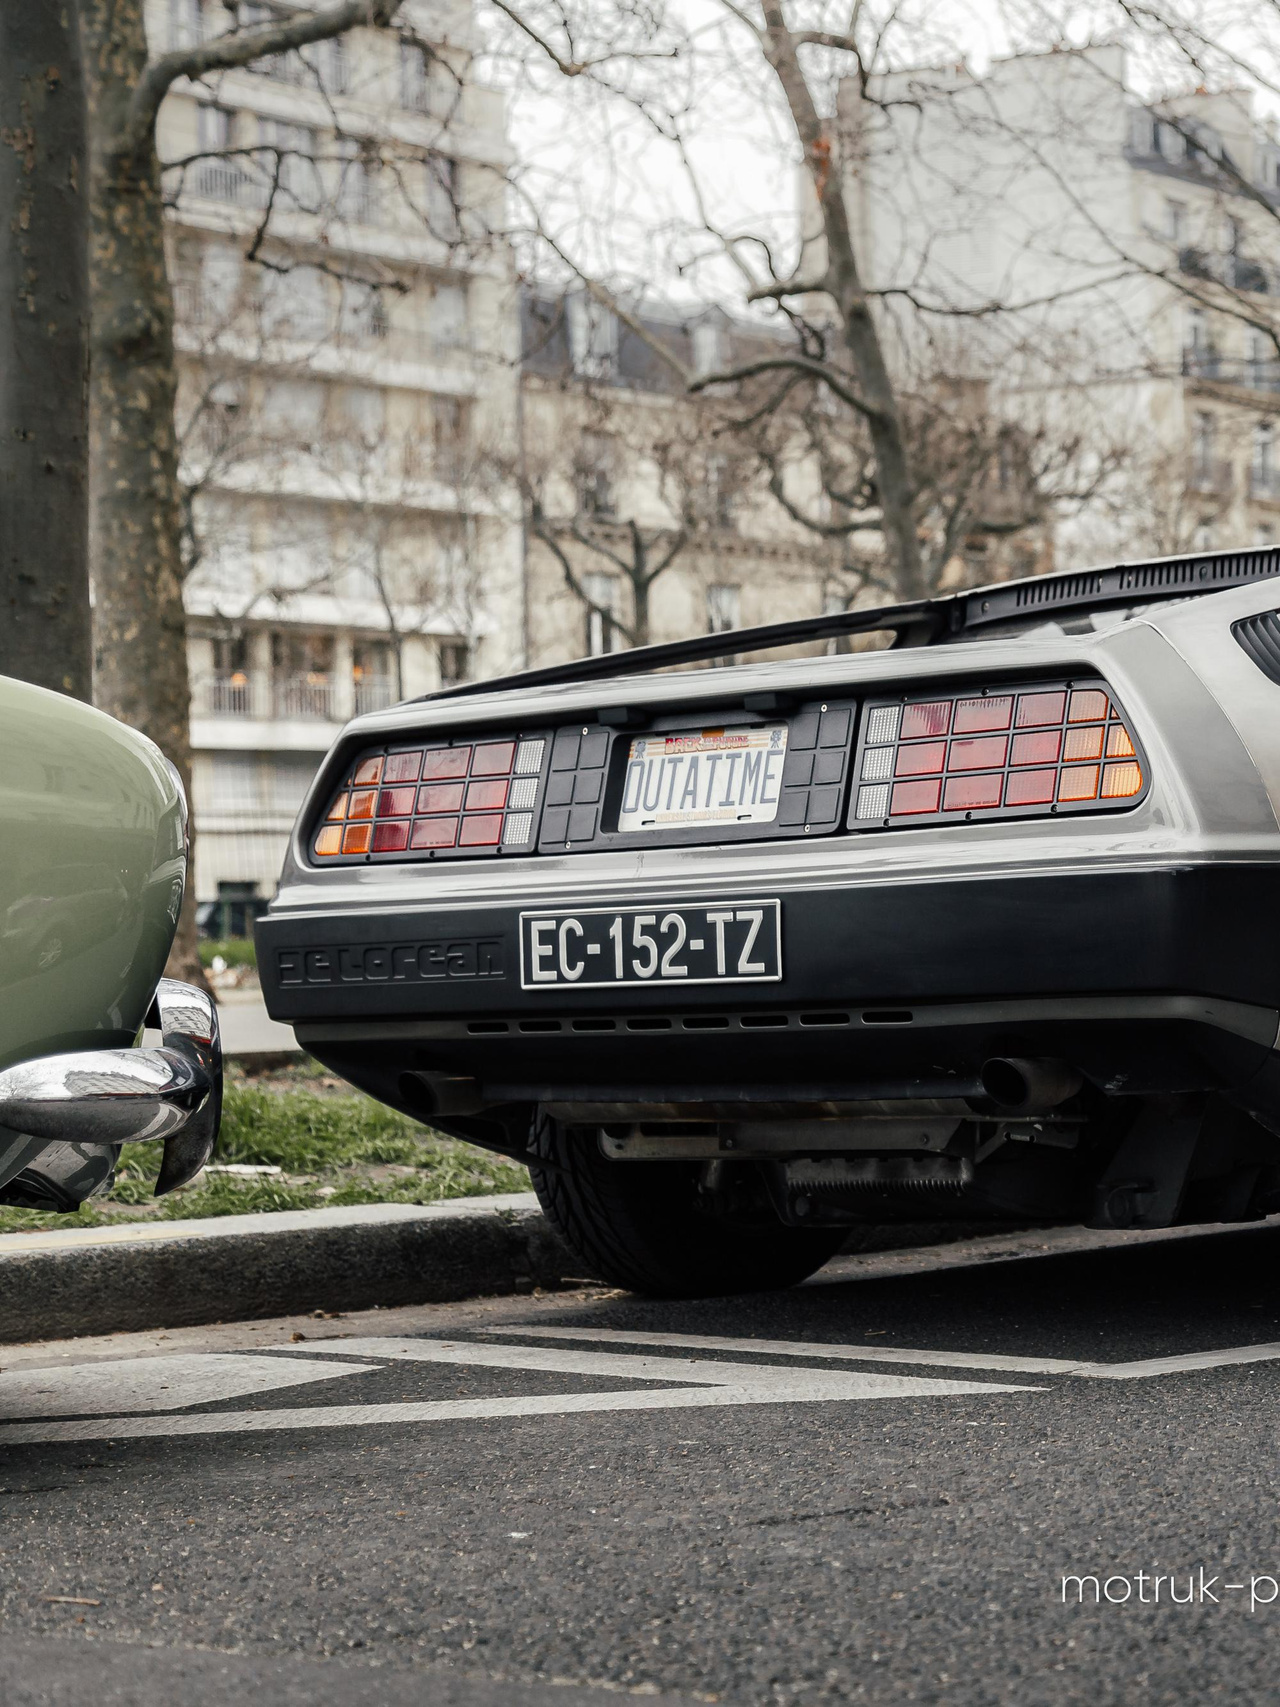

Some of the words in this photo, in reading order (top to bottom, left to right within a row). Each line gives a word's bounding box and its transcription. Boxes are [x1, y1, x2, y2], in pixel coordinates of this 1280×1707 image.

[665, 737, 701, 755] BACK
[622, 750, 784, 813] OUTATIME
[530, 910, 766, 982] EC-152-TZ
